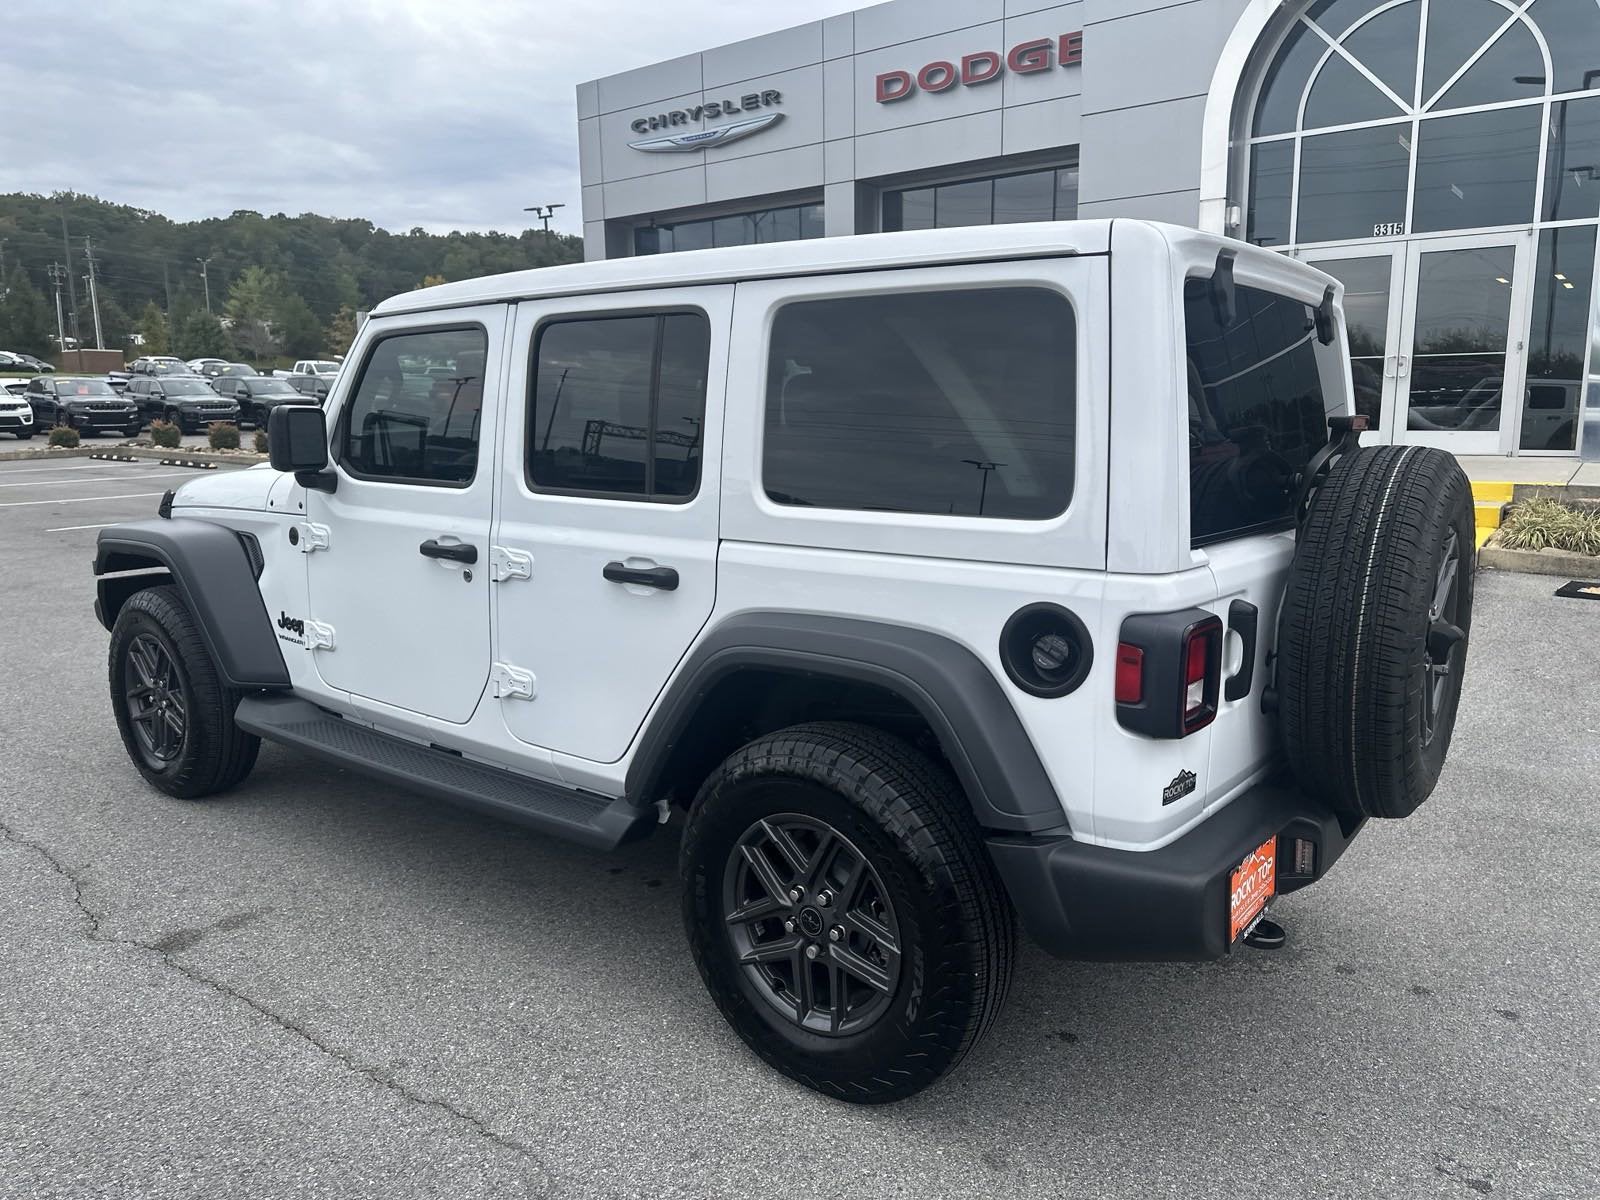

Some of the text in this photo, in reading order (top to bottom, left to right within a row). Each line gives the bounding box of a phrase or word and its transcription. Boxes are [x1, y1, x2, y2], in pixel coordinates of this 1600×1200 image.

[876, 30, 1083, 104] DODGE
[630, 89, 783, 134] CHRYSLER
[1375, 223, 1402, 236] 3315
[278, 611, 304, 637] Jeep
[1164, 782, 1186, 799] ROCKY
[1231, 873, 1257, 909] ROCKY
[1258, 856, 1273, 883] TOP
